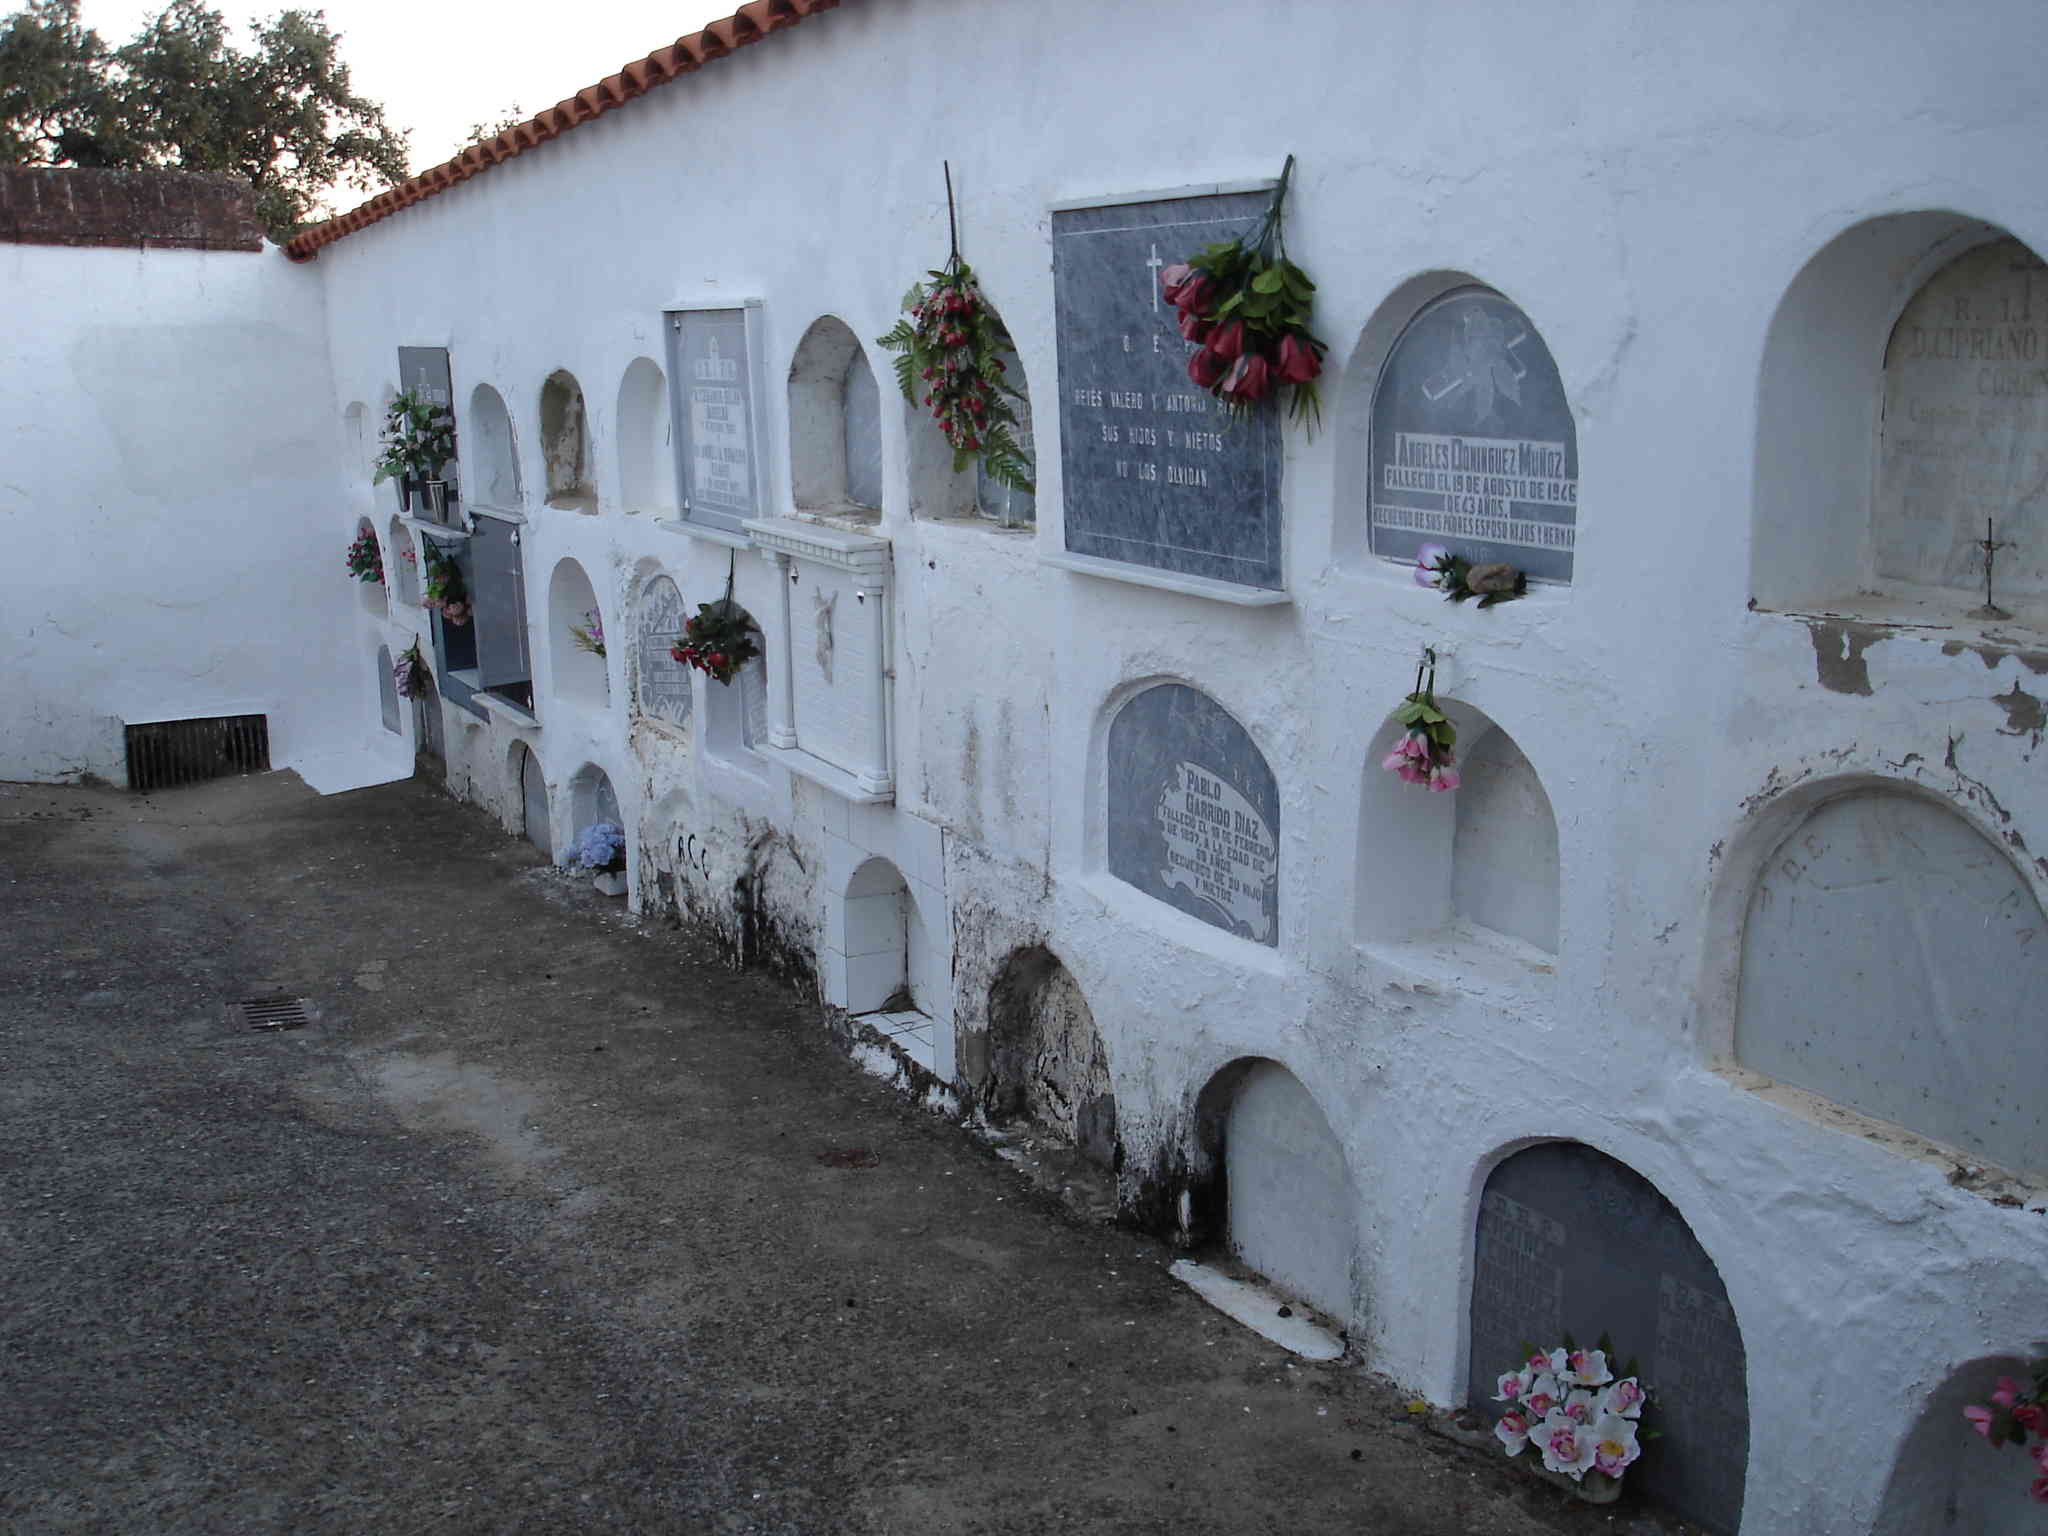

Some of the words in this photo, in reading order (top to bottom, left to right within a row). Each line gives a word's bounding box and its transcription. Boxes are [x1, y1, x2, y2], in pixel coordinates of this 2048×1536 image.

[1101, 423, 1120, 443] SUS
[1128, 427, 1158, 447] HIJOS
[1184, 430, 1225, 453] NIETOS
[1137, 462, 1157, 481] LOS
[1166, 463, 1209, 488] OLVIDAN
[1465, 475, 1481, 495] DE
[1483, 476, 1527, 499] AGOSTO
[1529, 480, 1545, 500] DE
[1447, 494, 1460, 513] DE
[1186, 768, 1221, 801] PABLO
[1185, 791, 1231, 828] GARRIDO
[1234, 809, 1259, 840] DIAZ
